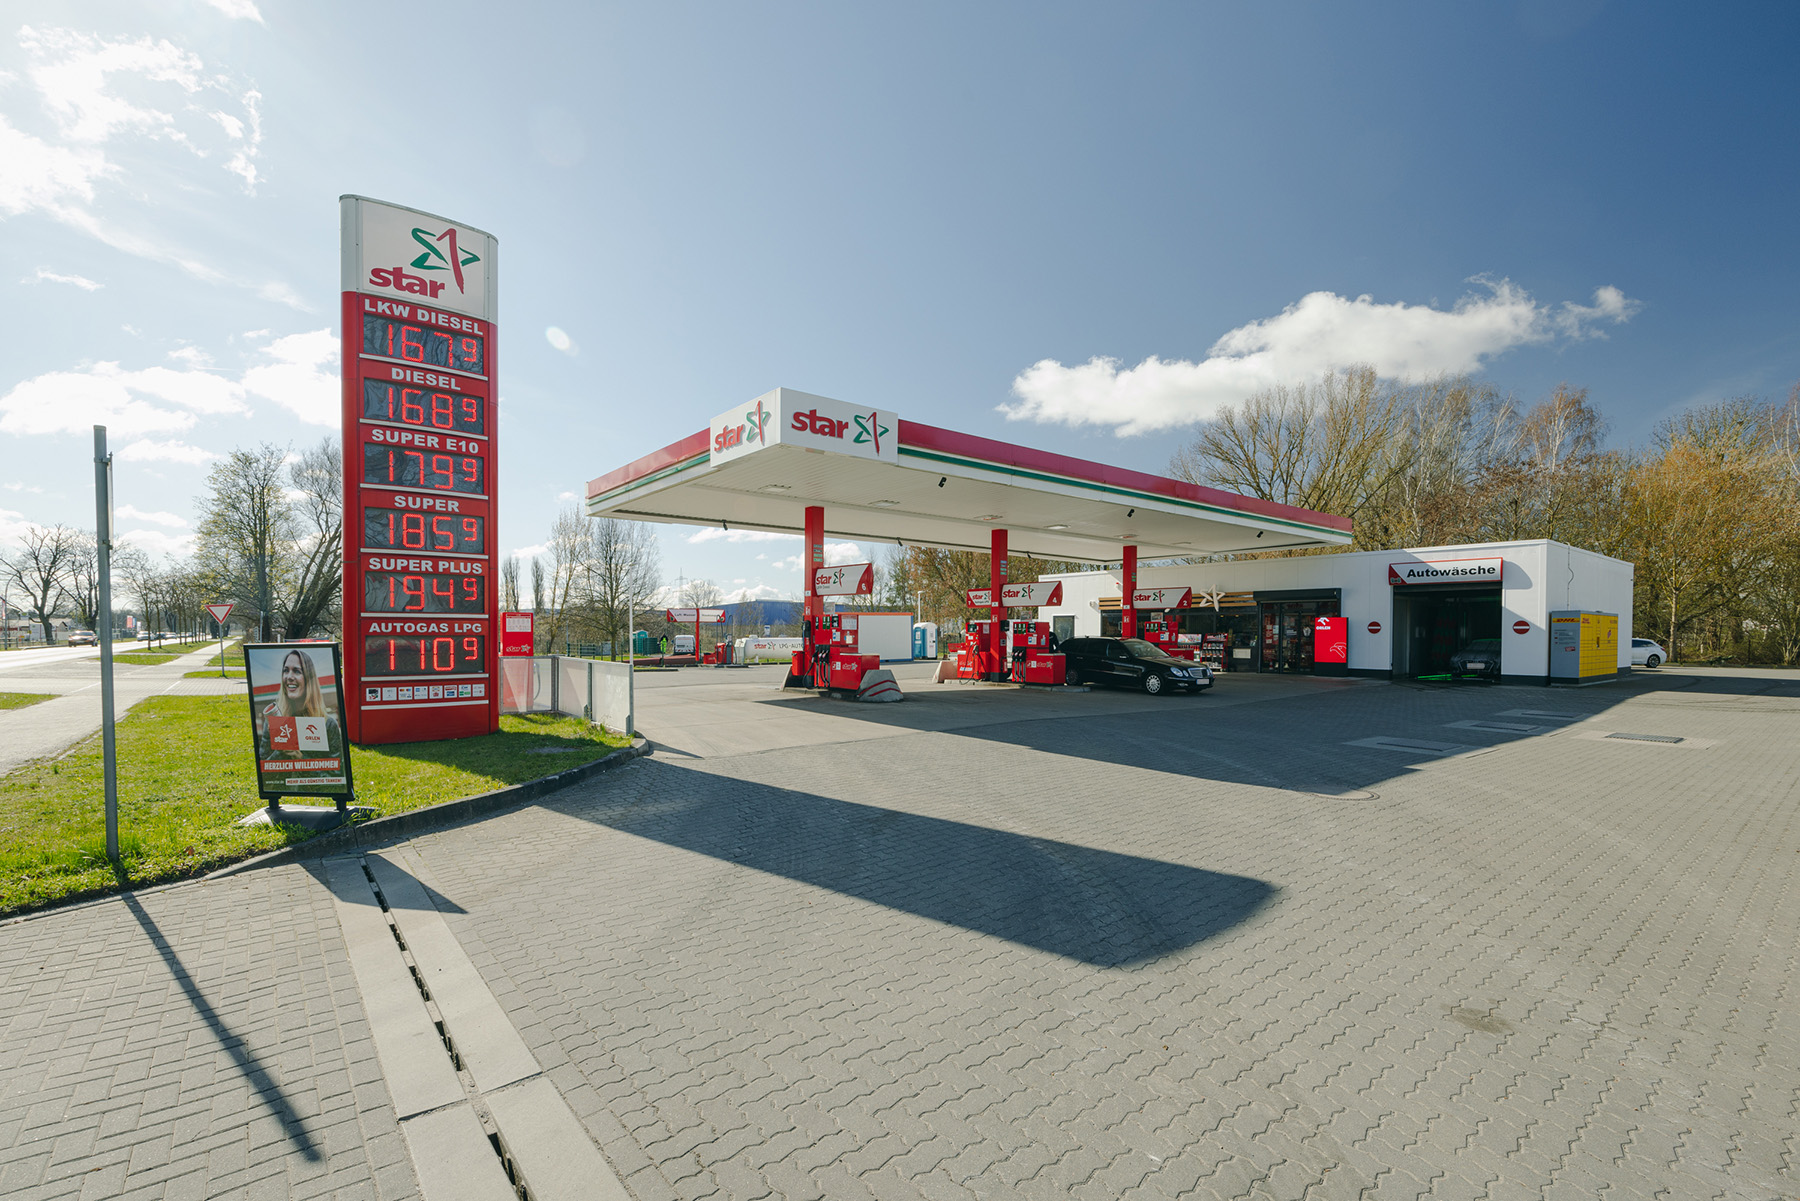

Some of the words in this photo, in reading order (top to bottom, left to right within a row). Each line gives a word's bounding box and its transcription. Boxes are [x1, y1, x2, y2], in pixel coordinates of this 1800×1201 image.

[369, 266, 445, 299] star
[364, 299, 410, 318] LKW
[417, 309, 483, 335] DIESEL
[391, 367, 461, 391] DIESEL
[791, 408, 849, 439] star
[372, 429, 440, 449] SUPER
[446, 437, 479, 454] E10
[714, 424, 745, 453] star
[394, 495, 460, 512] SUPER
[368, 557, 433, 572] SUPER
[438, 560, 483, 574] PLUS
[1407, 566, 1496, 578] Autowäsche
[816, 574, 832, 585] star
[972, 592, 983, 600] star
[1002, 588, 1020, 598] star
[1133, 593, 1151, 602] star
[369, 622, 449, 633] AUTOGAS
[454, 622, 482, 633] LPG
[264, 762, 294, 771] HERZLICH
[294, 760, 339, 770] WILLKOMMEN
